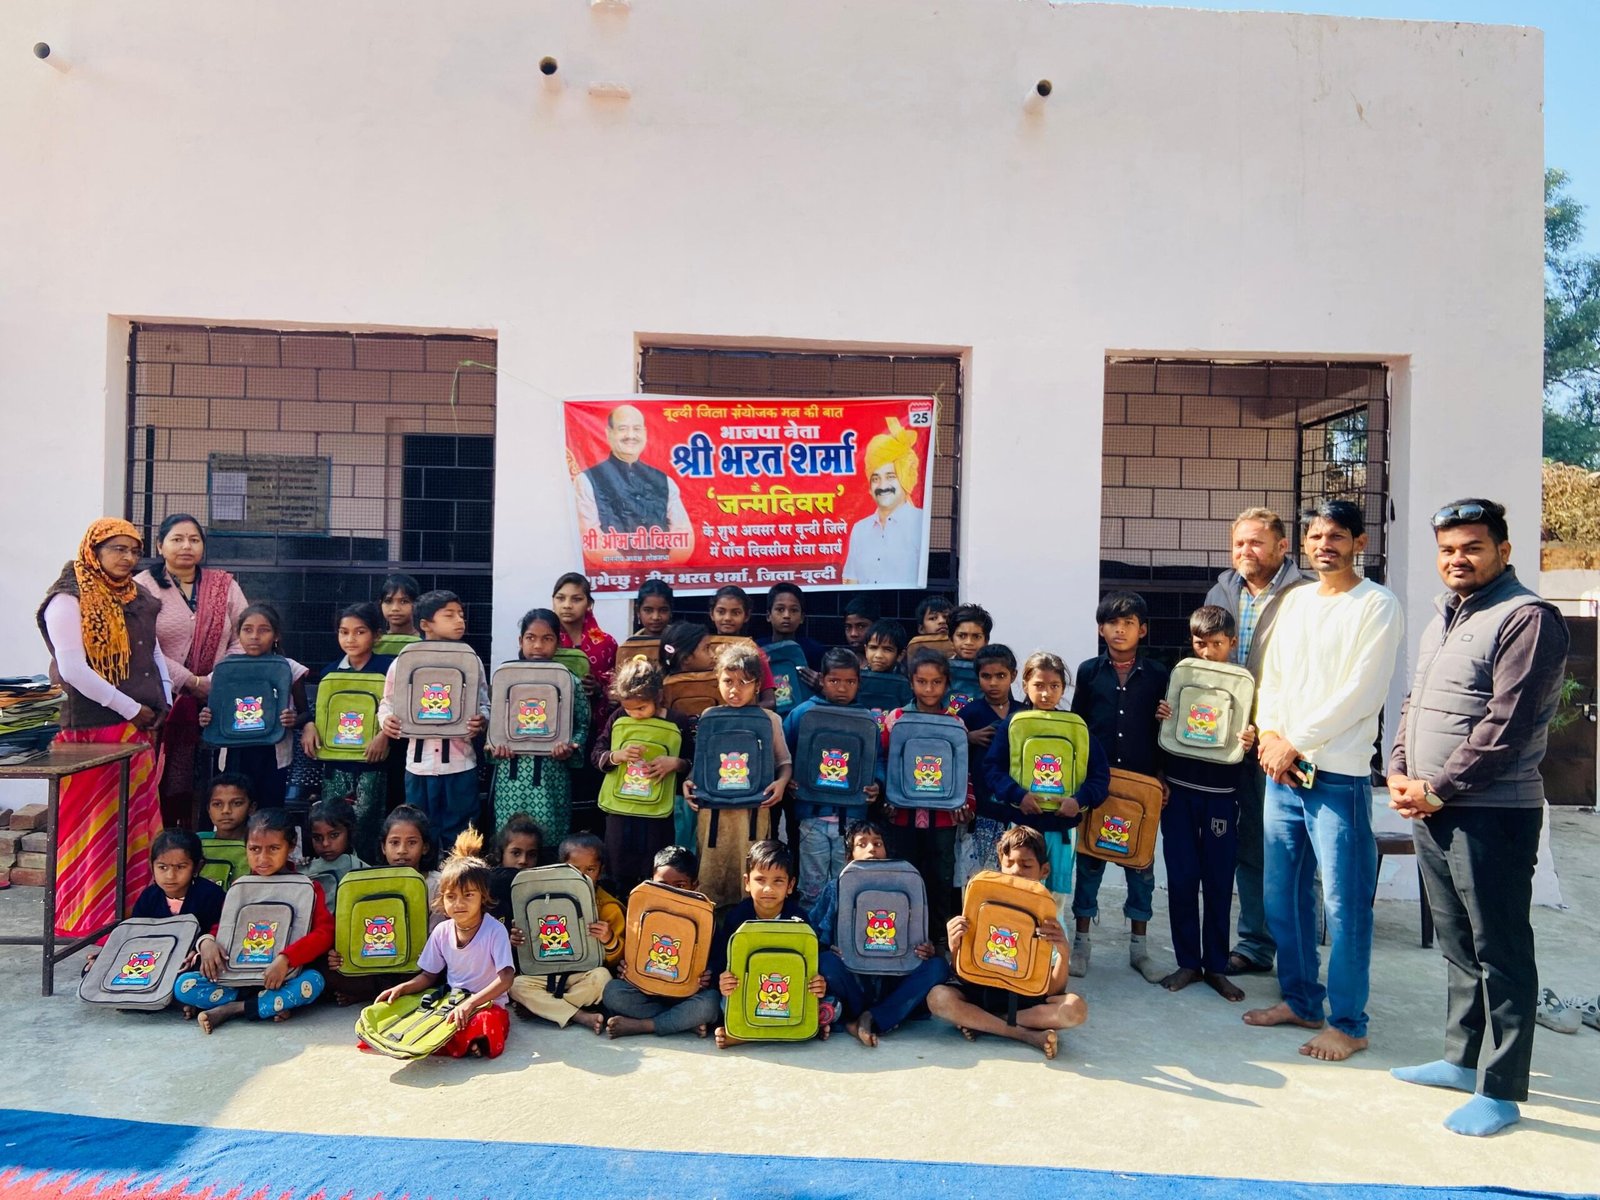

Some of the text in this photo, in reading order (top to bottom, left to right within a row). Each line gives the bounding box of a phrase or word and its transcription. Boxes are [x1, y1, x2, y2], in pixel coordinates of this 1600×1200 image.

[696, 404, 727, 418] जिला
[731, 403, 777, 419] संयोजक
[781, 407, 800, 418] मन
[803, 404, 819, 418] की
[822, 407, 843, 418] बात
[912, 412, 928, 424] 25
[720, 420, 820, 440] भाजपा नेता
[671, 429, 857, 477] श्री भरत शर्मा
[601, 525, 628, 550] ओम
[630, 525, 648, 550] जी
[702, 521, 715, 537] के
[717, 525, 738, 542] शुभ
[741, 524, 776, 537] अवसर
[778, 524, 792, 536] पर
[823, 518, 848, 536] जिले
[709, 539, 843, 557] में पाँच दिवसीय सेवा कार्य
[678, 572, 711, 584] भरत
[714, 568, 753, 583] शर्मा,
